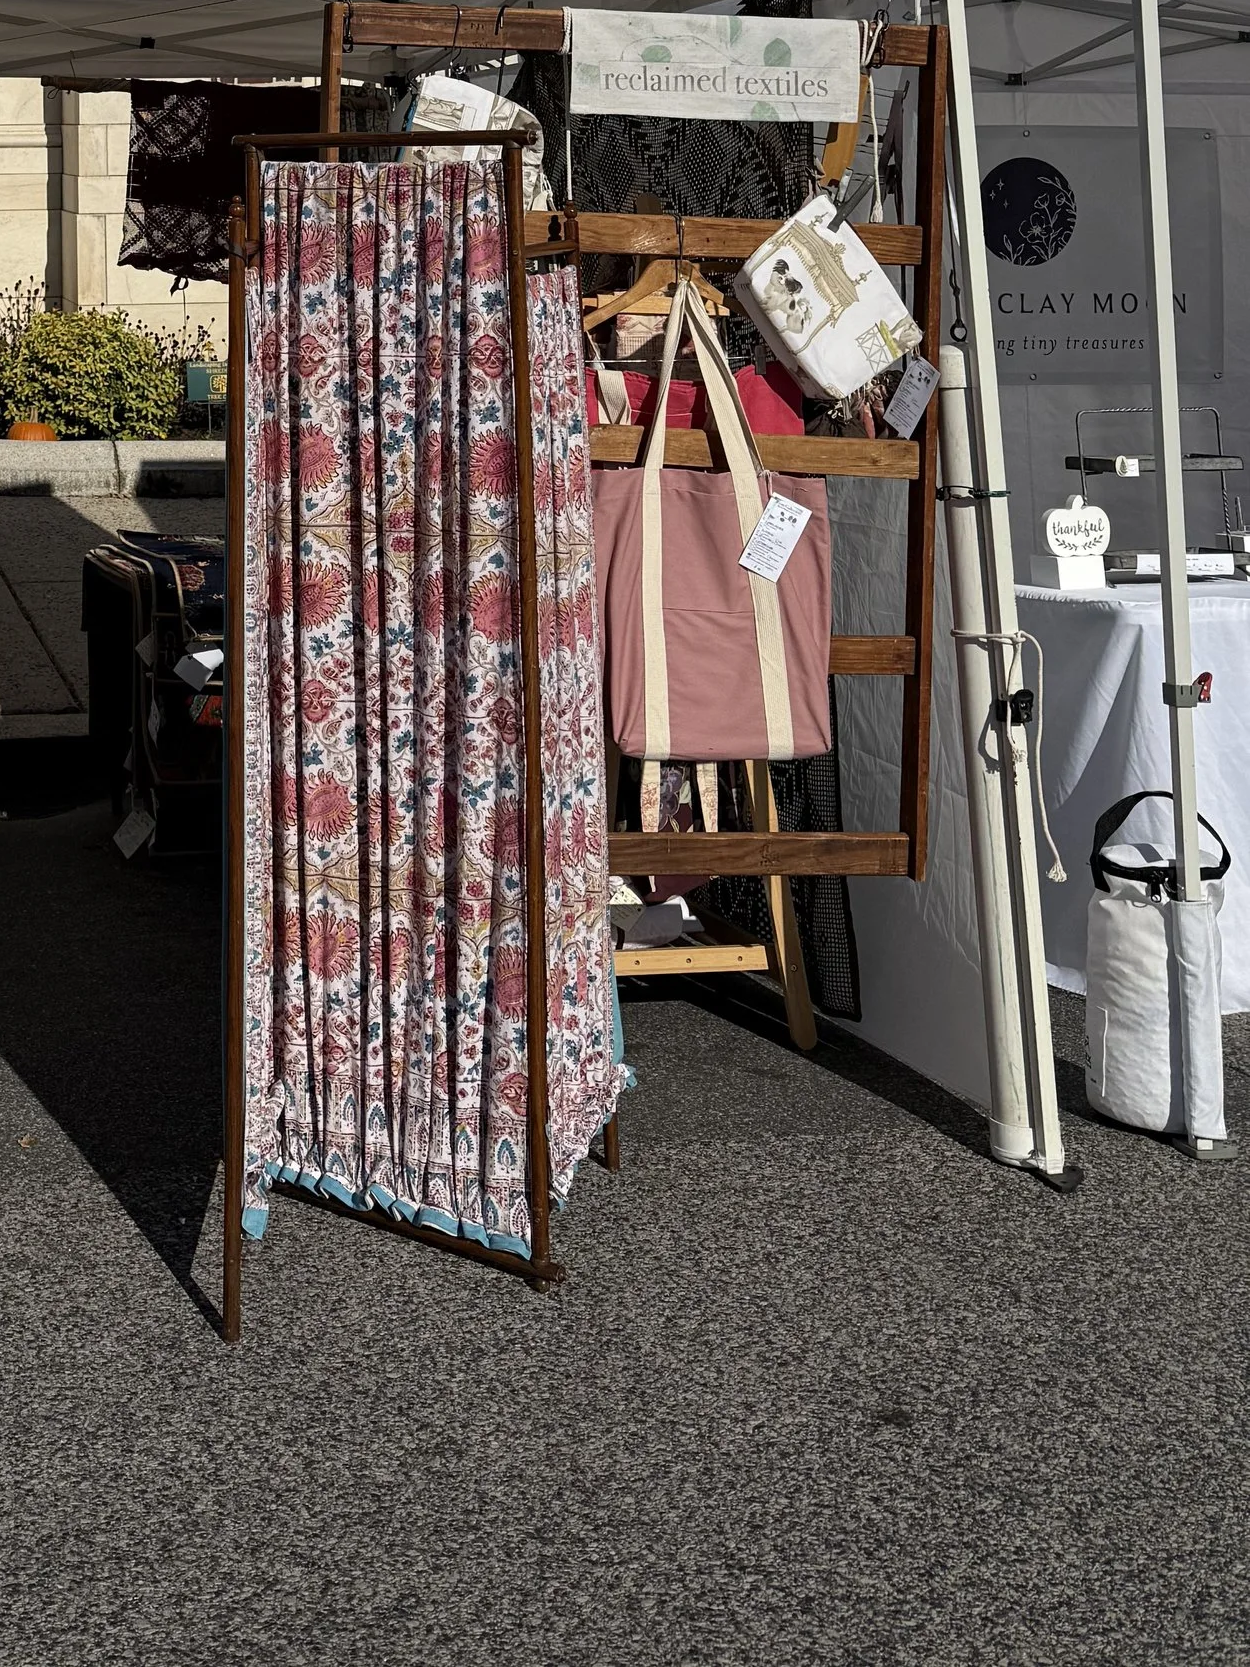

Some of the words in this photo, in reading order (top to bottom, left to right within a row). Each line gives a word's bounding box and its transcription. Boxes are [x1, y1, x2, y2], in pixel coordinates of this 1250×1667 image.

[602, 65, 727, 94] reclaimed
[735, 70, 828, 98] textiles
[997, 292, 1075, 314] CLAY
[1093, 292, 1187, 314] MON
[1023, 335, 1058, 355] tiny
[1066, 335, 1145, 350] treasures
[1053, 518, 1105, 537] thankful
